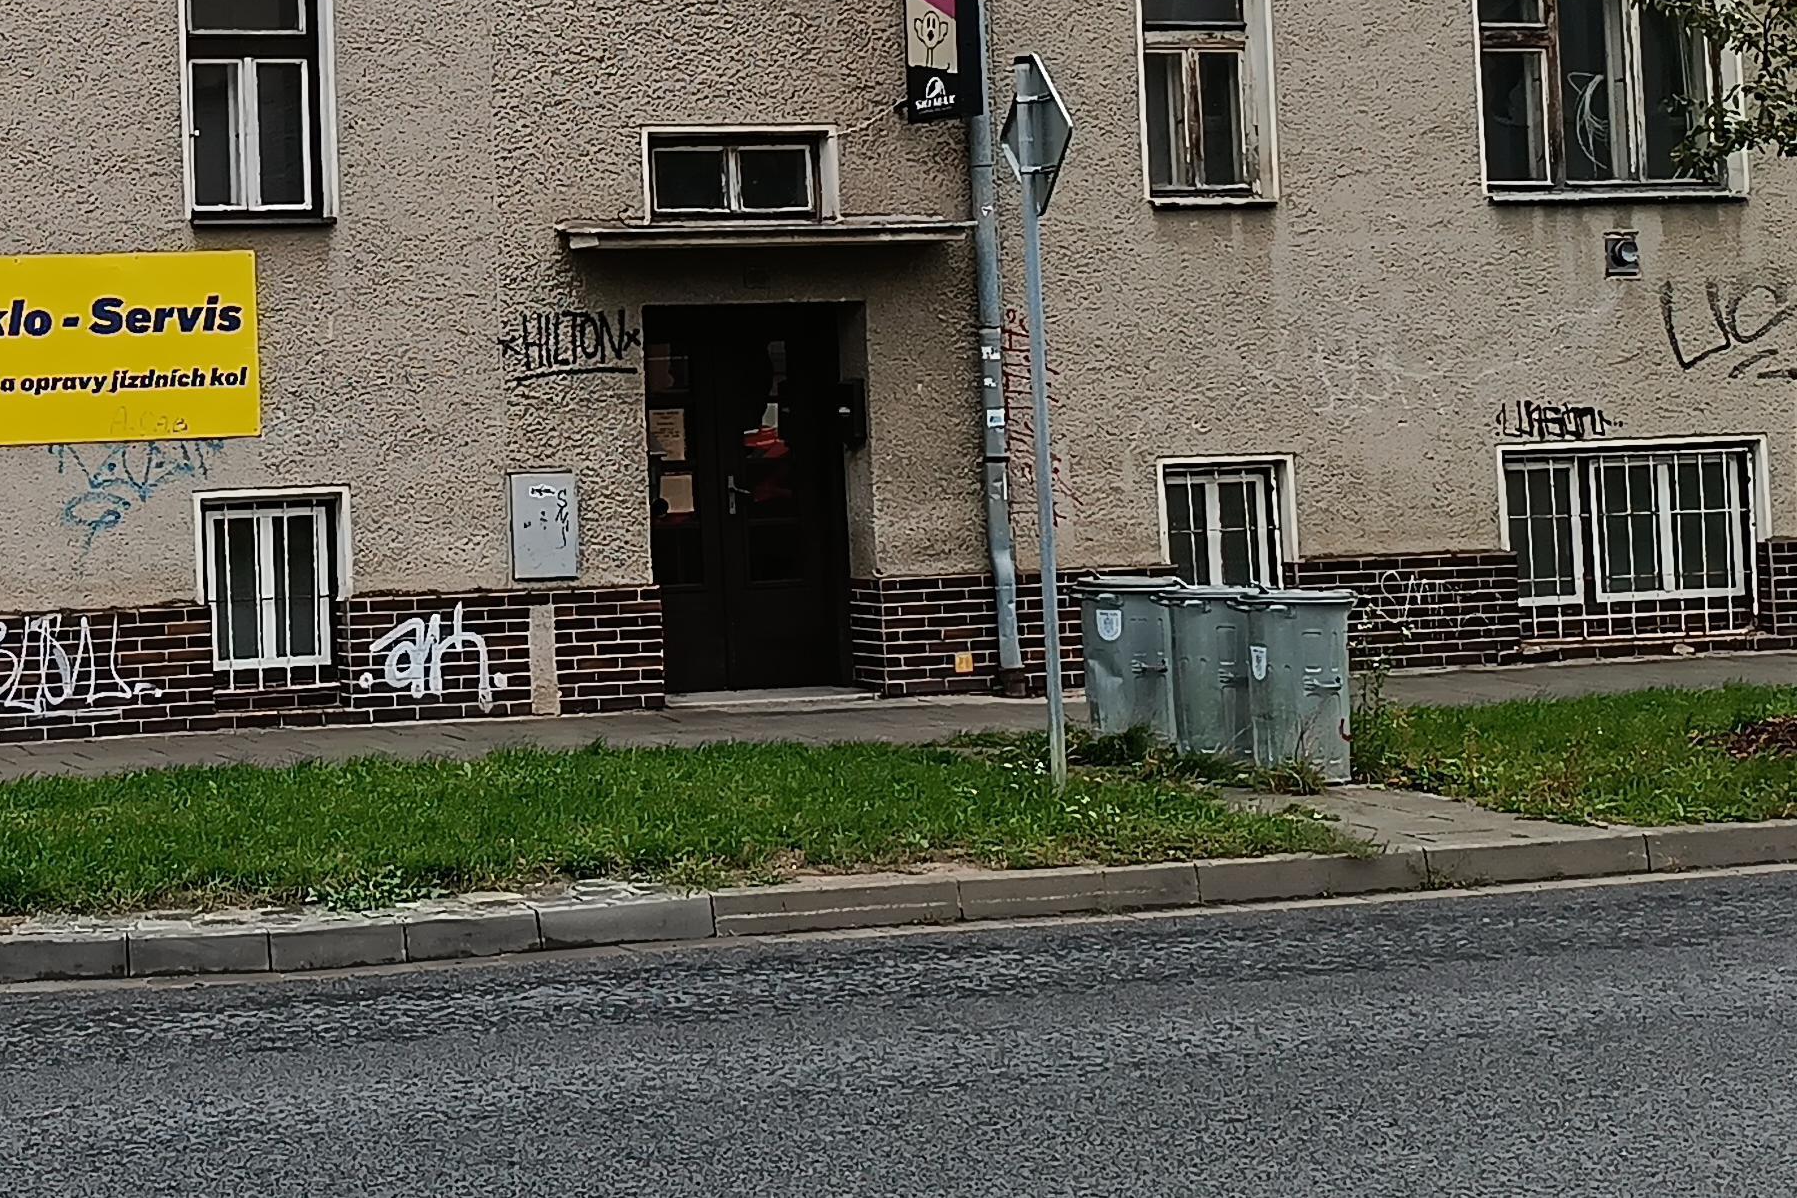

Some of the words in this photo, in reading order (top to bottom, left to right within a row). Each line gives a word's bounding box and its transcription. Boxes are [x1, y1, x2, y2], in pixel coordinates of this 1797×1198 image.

[88, 295, 242, 335] Servis
[0, 379, 15, 392] a
[20, 373, 107, 395] opravy
[107, 368, 206, 393] jízdních
[209, 367, 248, 387] kol
